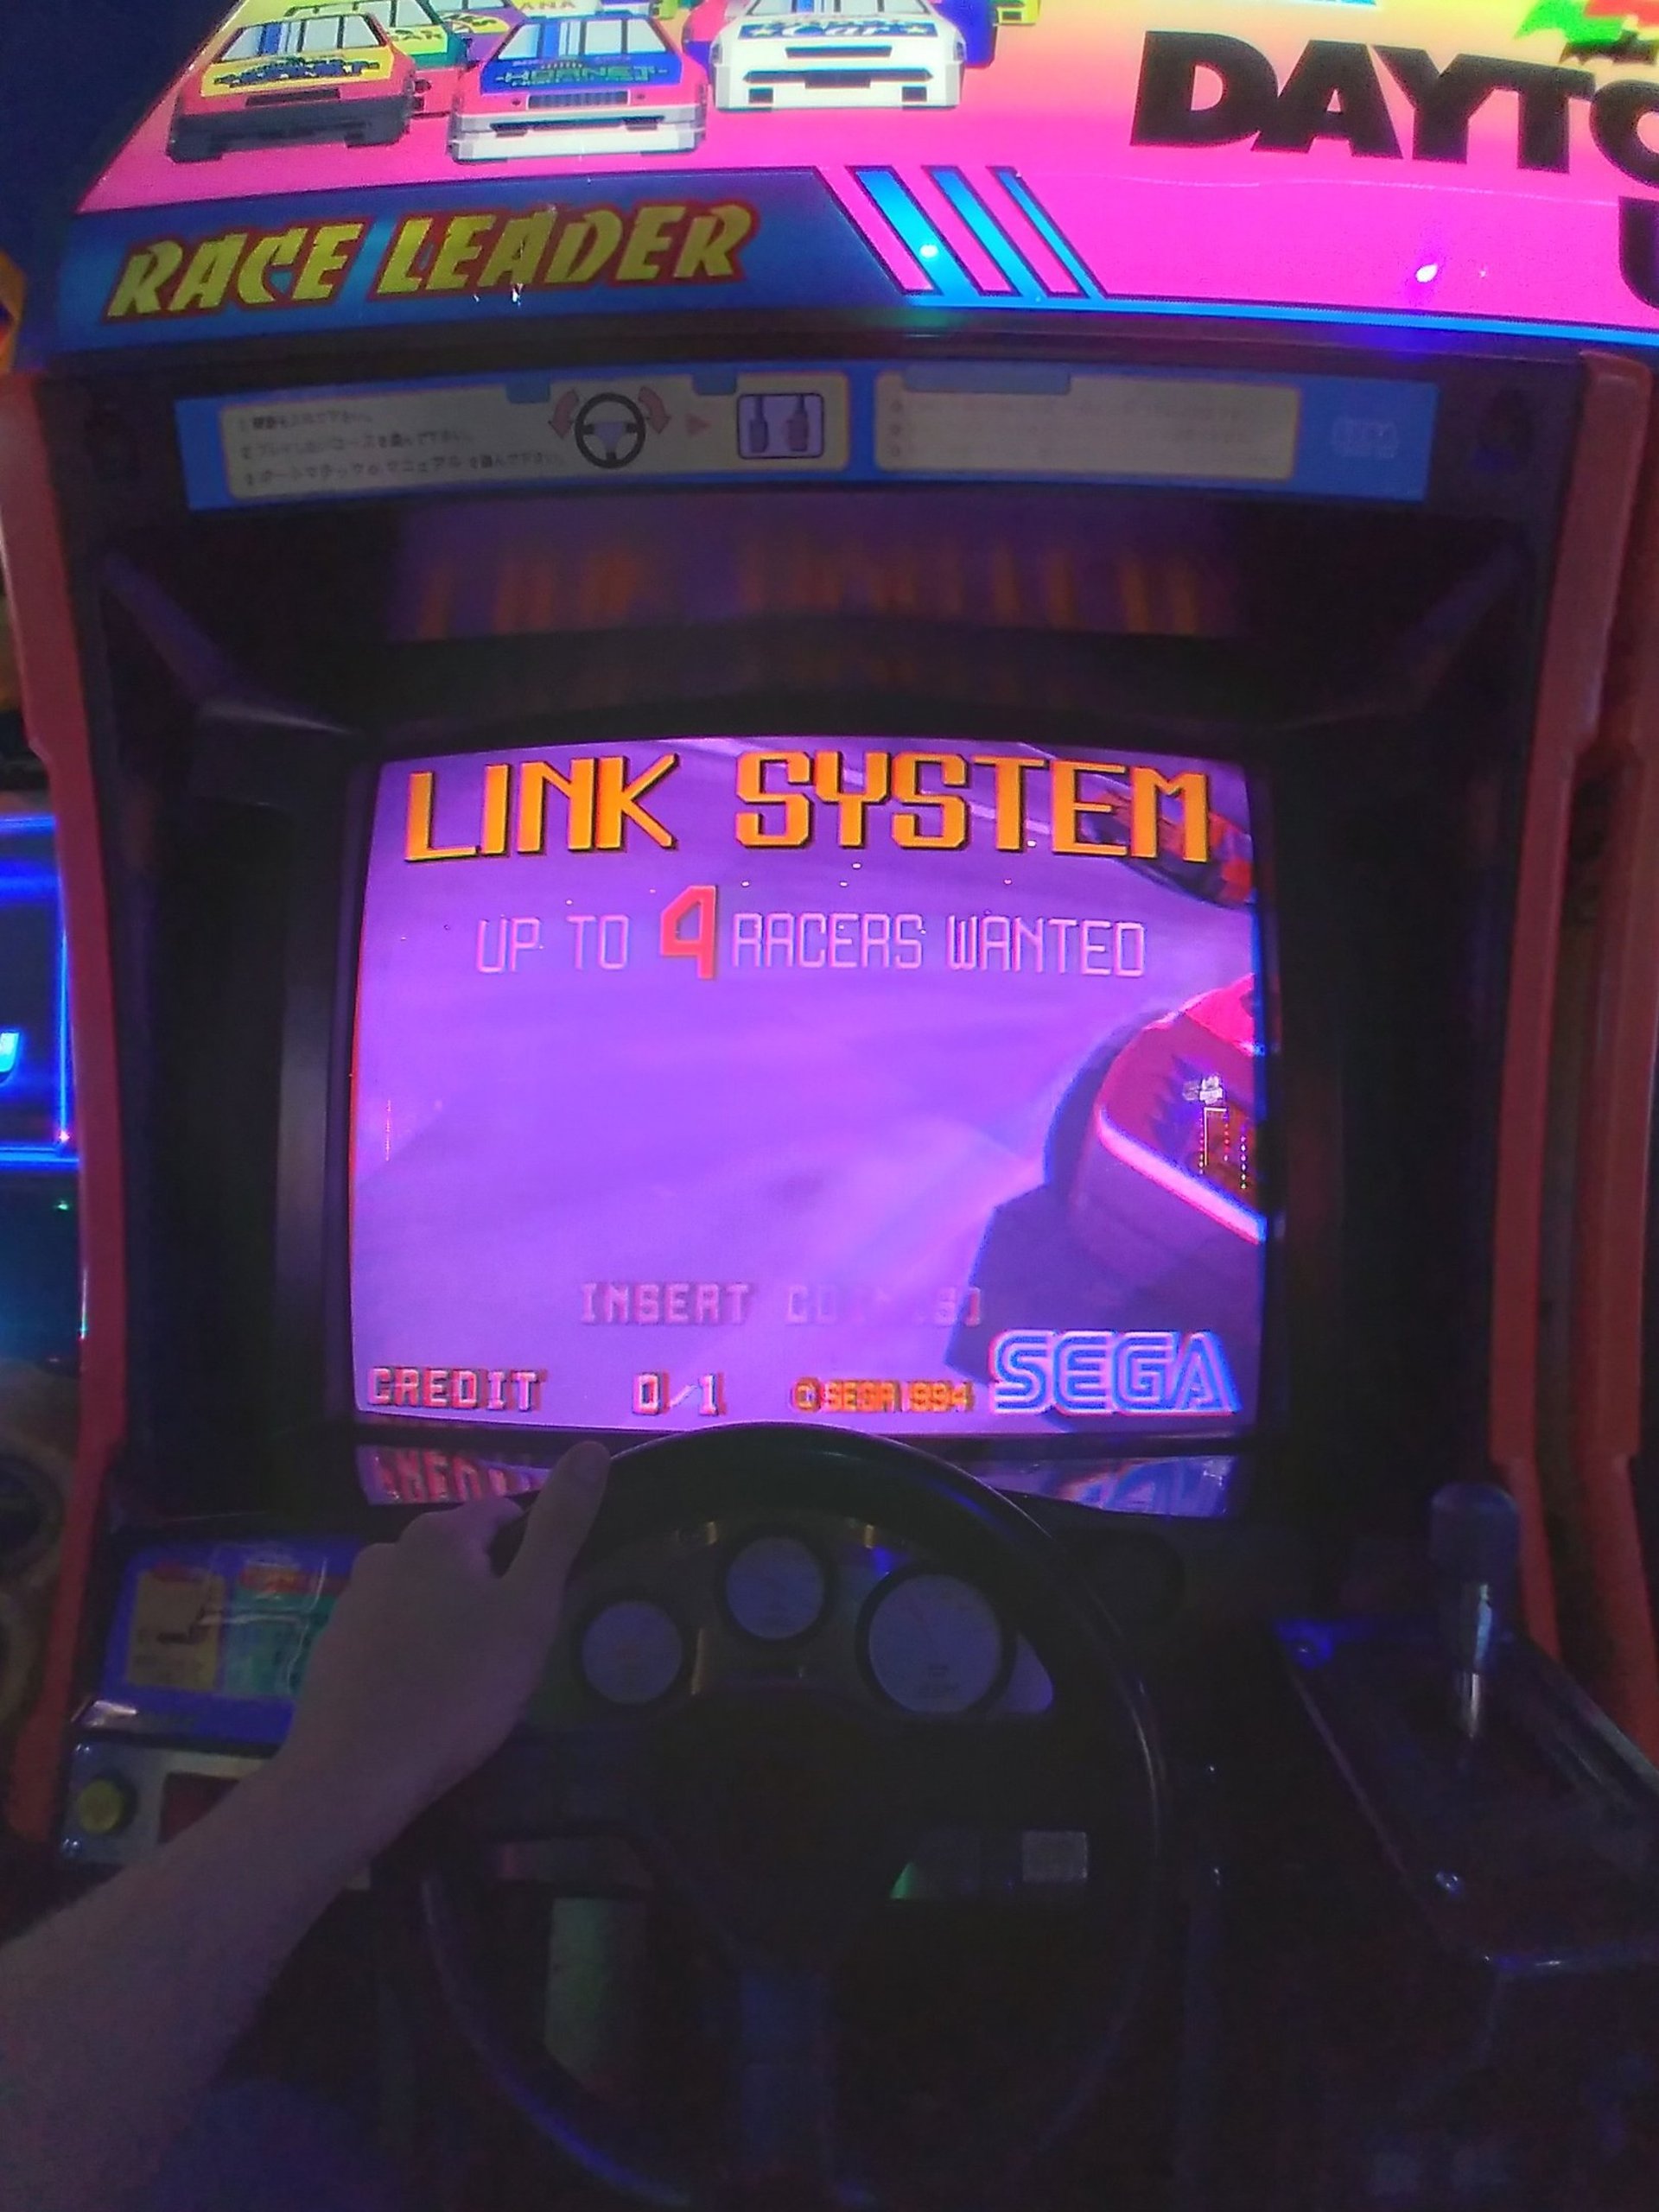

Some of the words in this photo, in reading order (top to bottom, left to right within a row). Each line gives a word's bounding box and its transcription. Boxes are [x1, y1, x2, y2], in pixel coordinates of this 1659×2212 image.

[105, 220, 368, 321] RACE
[374, 203, 758, 296] LEADER
[405, 752, 680, 862] LINK
[735, 750, 1210, 863] SYSTEM
[476, 915, 542, 974] UP
[566, 914, 629, 970] TO
[660, 885, 718, 980] 4
[732, 912, 925, 970] RACERS
[949, 915, 1145, 977] WANTED
[580, 1282, 751, 1325] INSERT
[367, 1366, 546, 1412] CREDIT
[988, 1328, 1241, 1417] SEGA
